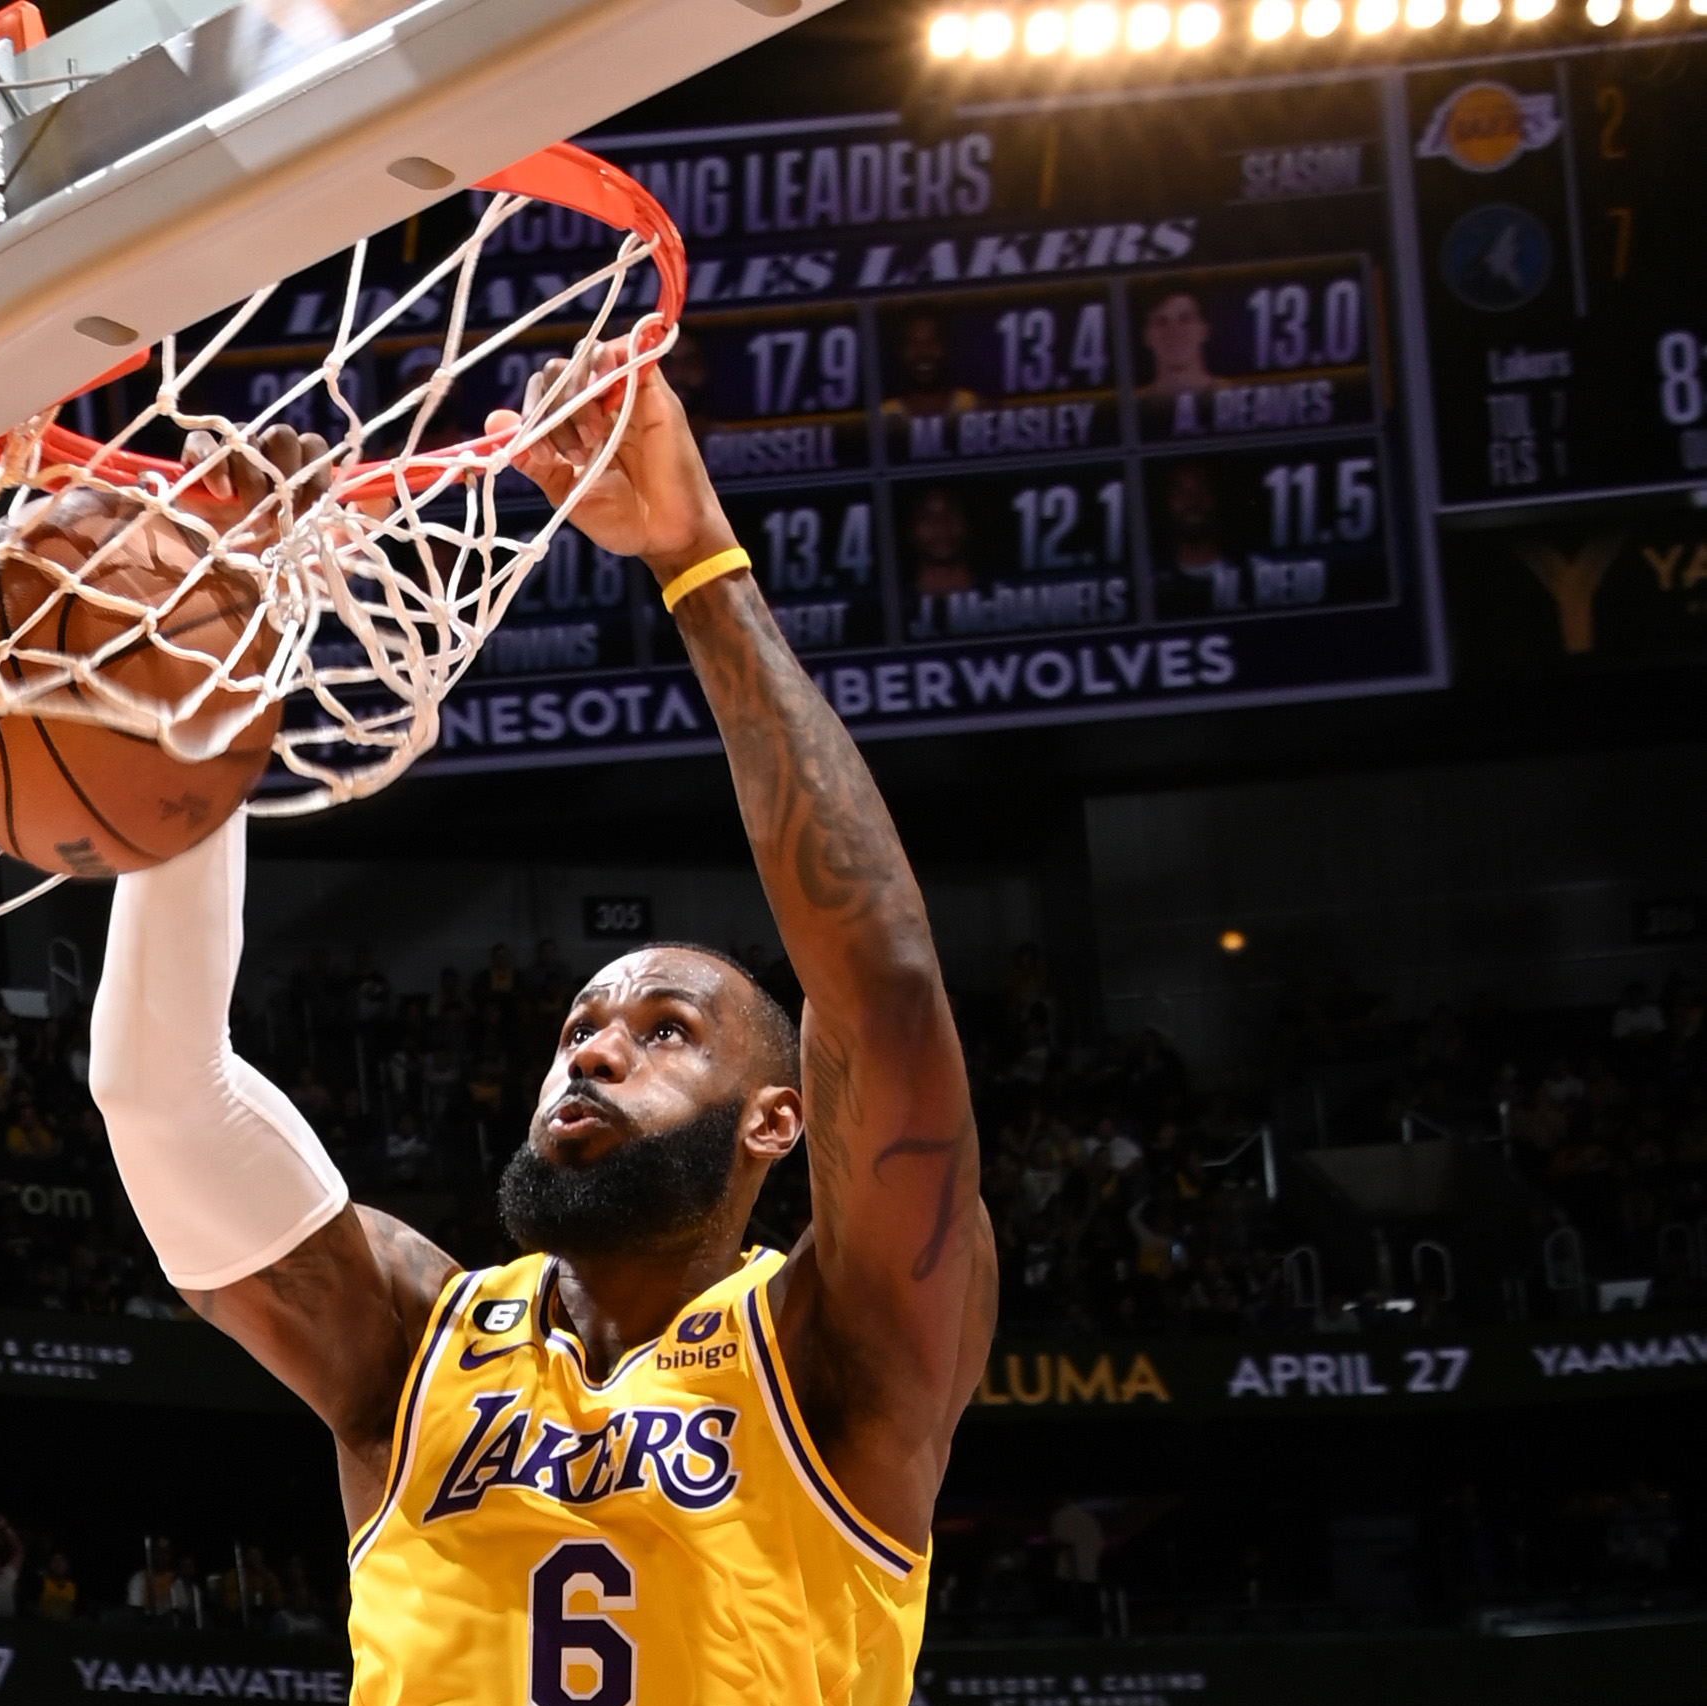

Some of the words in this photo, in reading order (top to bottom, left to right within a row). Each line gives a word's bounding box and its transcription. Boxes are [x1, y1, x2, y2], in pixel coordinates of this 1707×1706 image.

[856, 216, 1199, 288] LAKERS
[748, 325, 857, 411] 17.9
[995, 302, 1109, 395] 13.4
[1246, 277, 1361, 371] 13.0
[760, 502, 873, 593] 13.4
[1012, 480, 1126, 572] 12.1
[1263, 456, 1376, 550] 11.5
[484, 1302, 518, 1332] 6
[655, 1341, 738, 1371] bibigo
[977, 1350, 1172, 1407] LUMA
[1227, 1350, 1389, 1401] APRIL
[1403, 1345, 1471, 1394] 27
[420, 1387, 743, 1527] LAKERS
